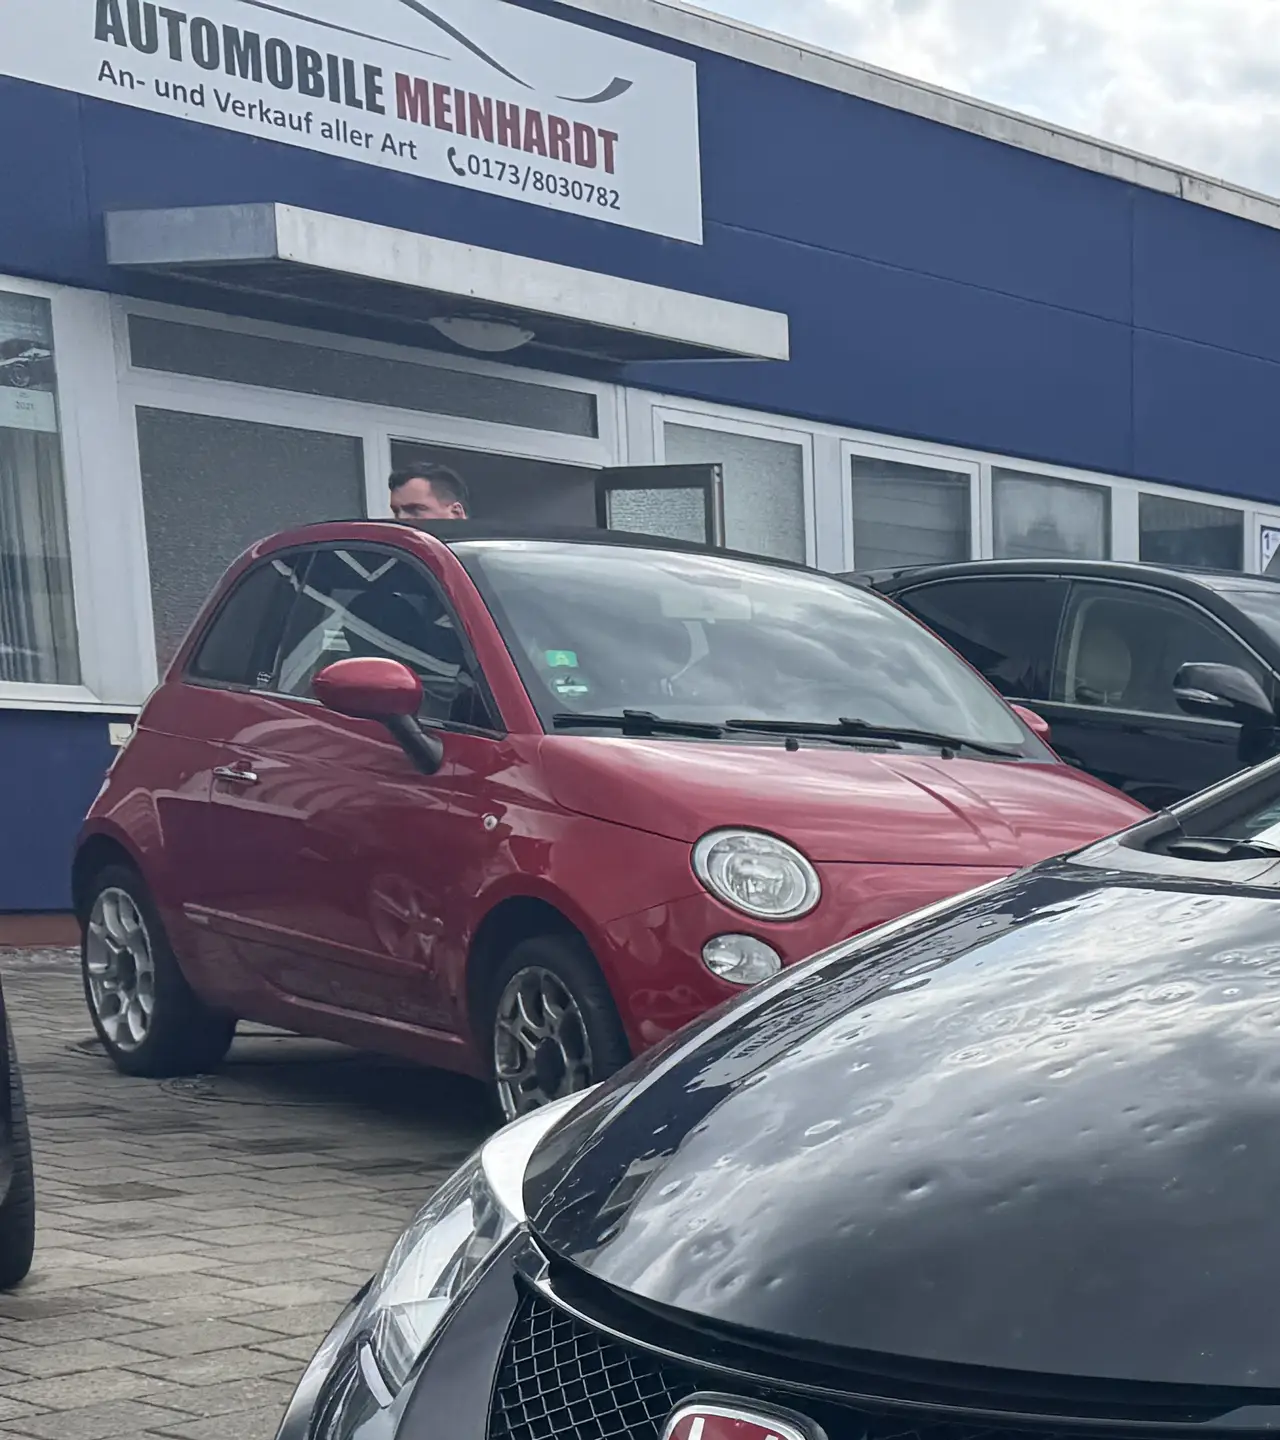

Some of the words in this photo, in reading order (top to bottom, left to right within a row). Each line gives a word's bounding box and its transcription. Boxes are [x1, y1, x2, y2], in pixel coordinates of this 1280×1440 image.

[94, 0, 386, 115] AUTOMOBILE
[395, 72, 618, 175] MEINHARDT
[98, 60, 146, 90] An-
[155, 78, 205, 107] und
[213, 88, 313, 134] Verkauf
[320, 119, 373, 149] aller
[381, 133, 418, 160] Art
[467, 155, 621, 210] 0173/8030782
